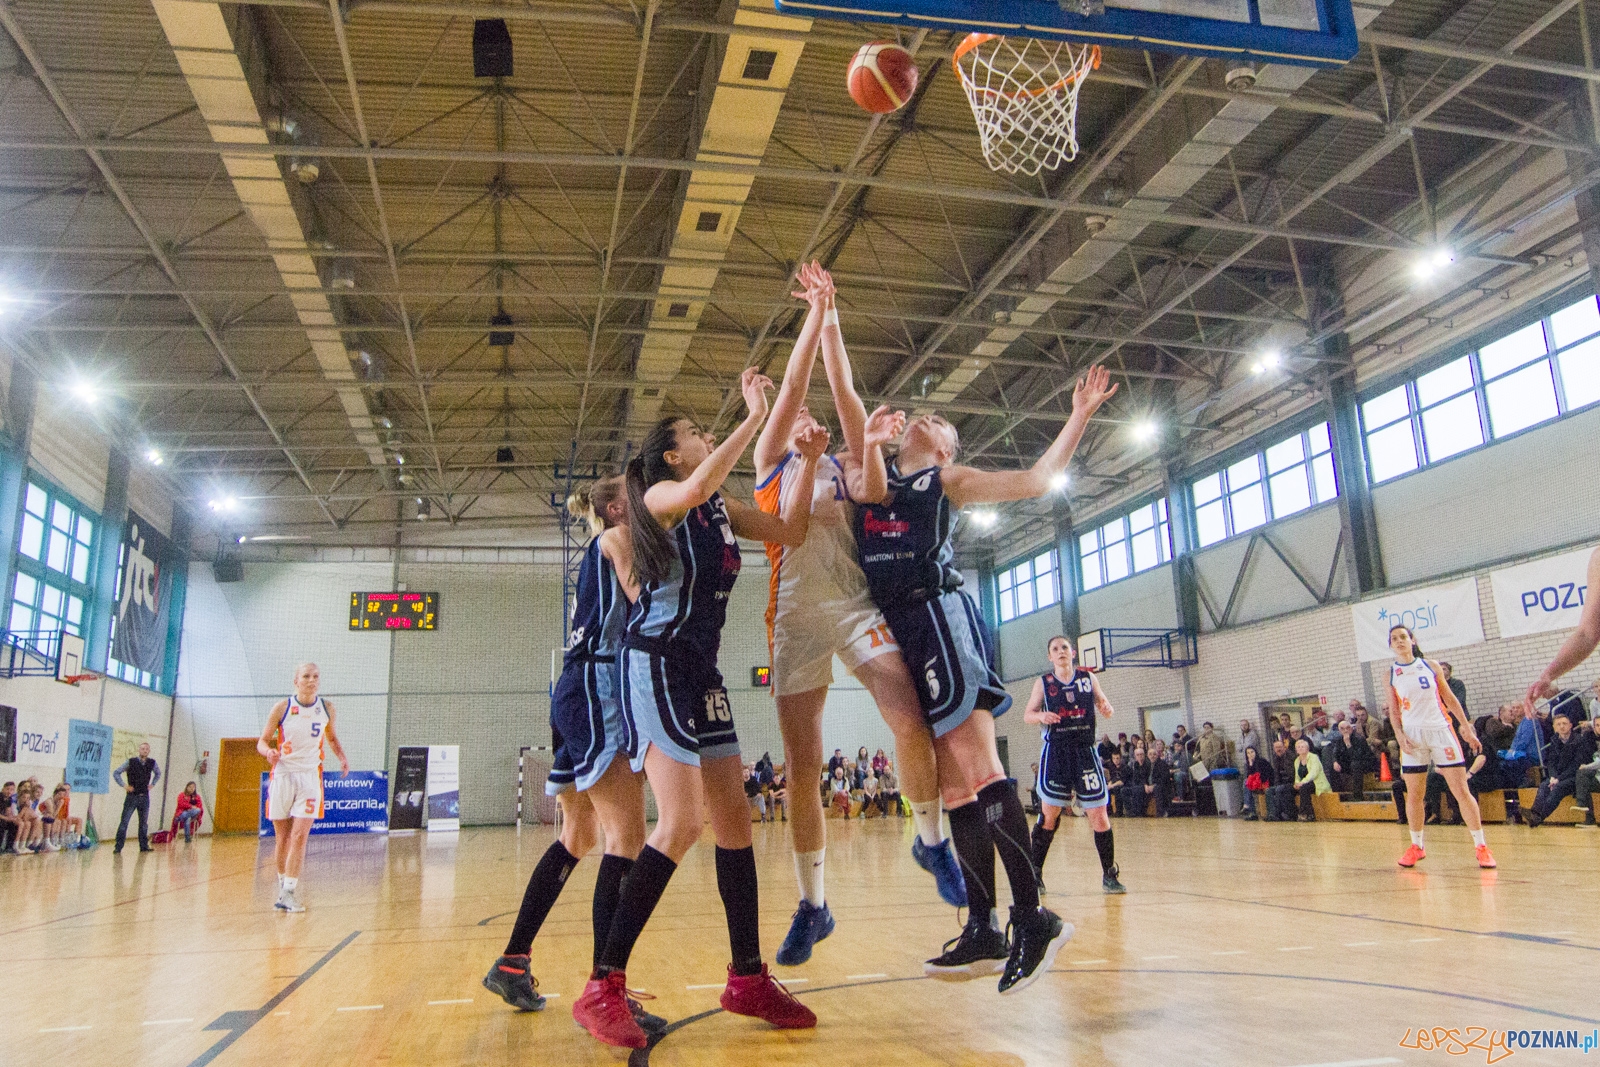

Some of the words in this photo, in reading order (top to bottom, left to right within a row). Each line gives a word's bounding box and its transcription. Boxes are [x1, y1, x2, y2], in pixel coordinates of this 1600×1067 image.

[912, 471, 935, 491] 6
[367, 601, 381, 613] 52
[411, 601, 424, 613] 49
[926, 669, 940, 700] 6
[1074, 677, 1092, 693] 13
[1418, 676, 1431, 690] 9
[705, 693, 731, 722] 15
[311, 722, 321, 737] 5
[1444, 746, 1456, 761] 9
[324, 779, 374, 789] ternetowy
[1082, 772, 1100, 791] 13
[305, 799, 316, 814] 5
[324, 798, 385, 810] anczarnia.pl
